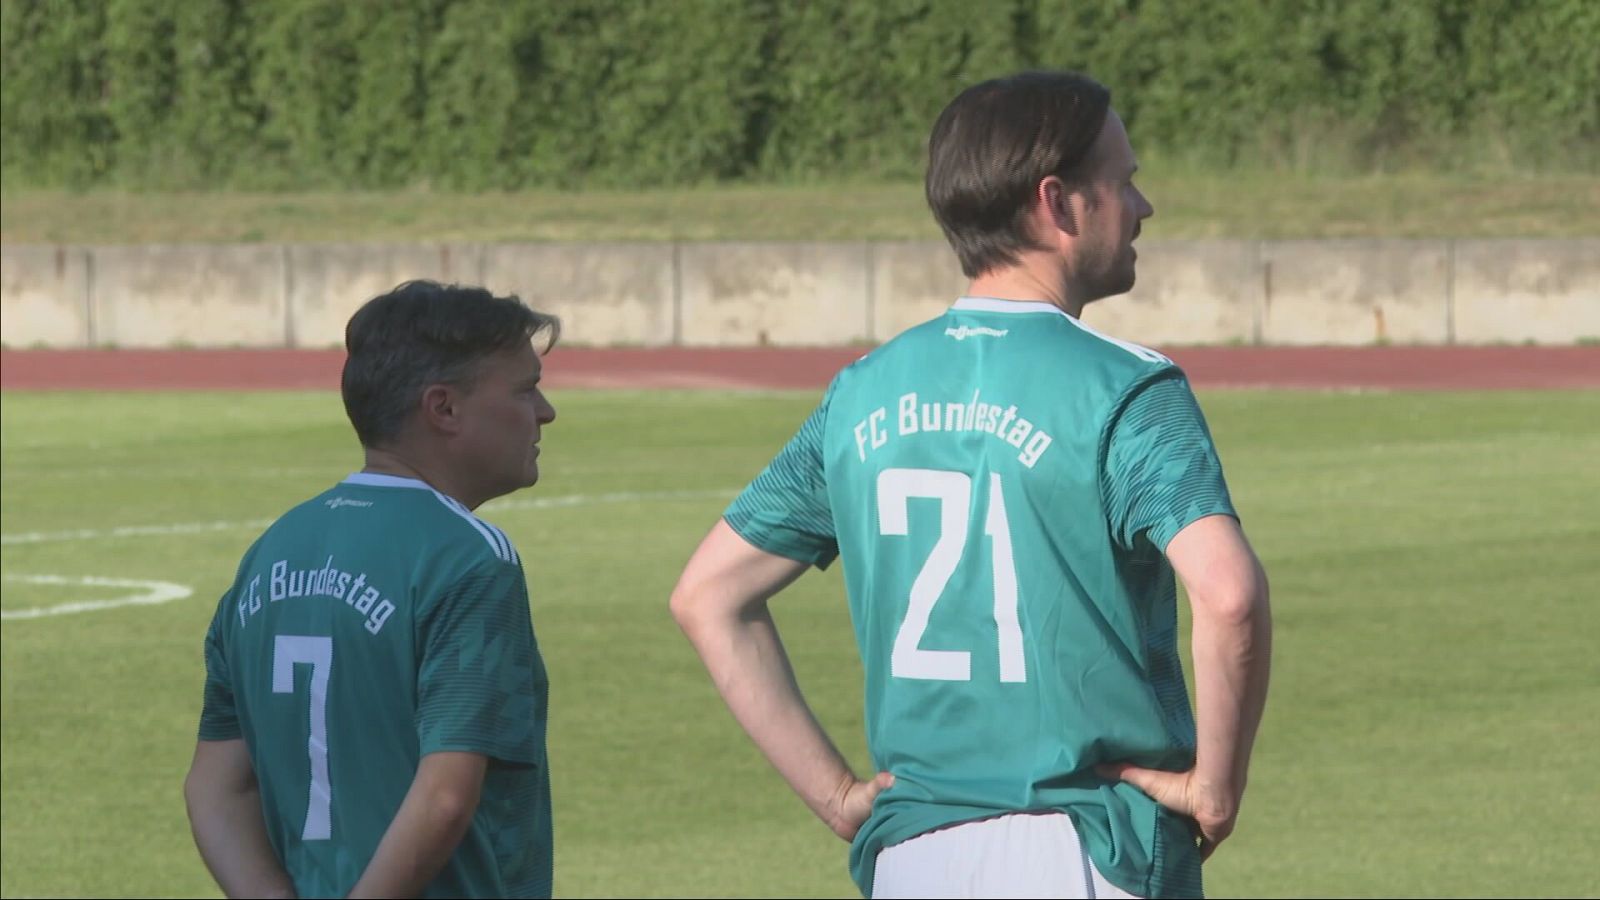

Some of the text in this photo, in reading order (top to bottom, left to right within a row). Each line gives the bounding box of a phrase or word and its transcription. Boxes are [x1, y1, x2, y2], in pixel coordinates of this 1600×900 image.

[854, 388, 1053, 469] FC Bundestag
[238, 555, 396, 636] FC Bundestag
[877, 467, 1027, 683] 21
[272, 634, 333, 840] 7
